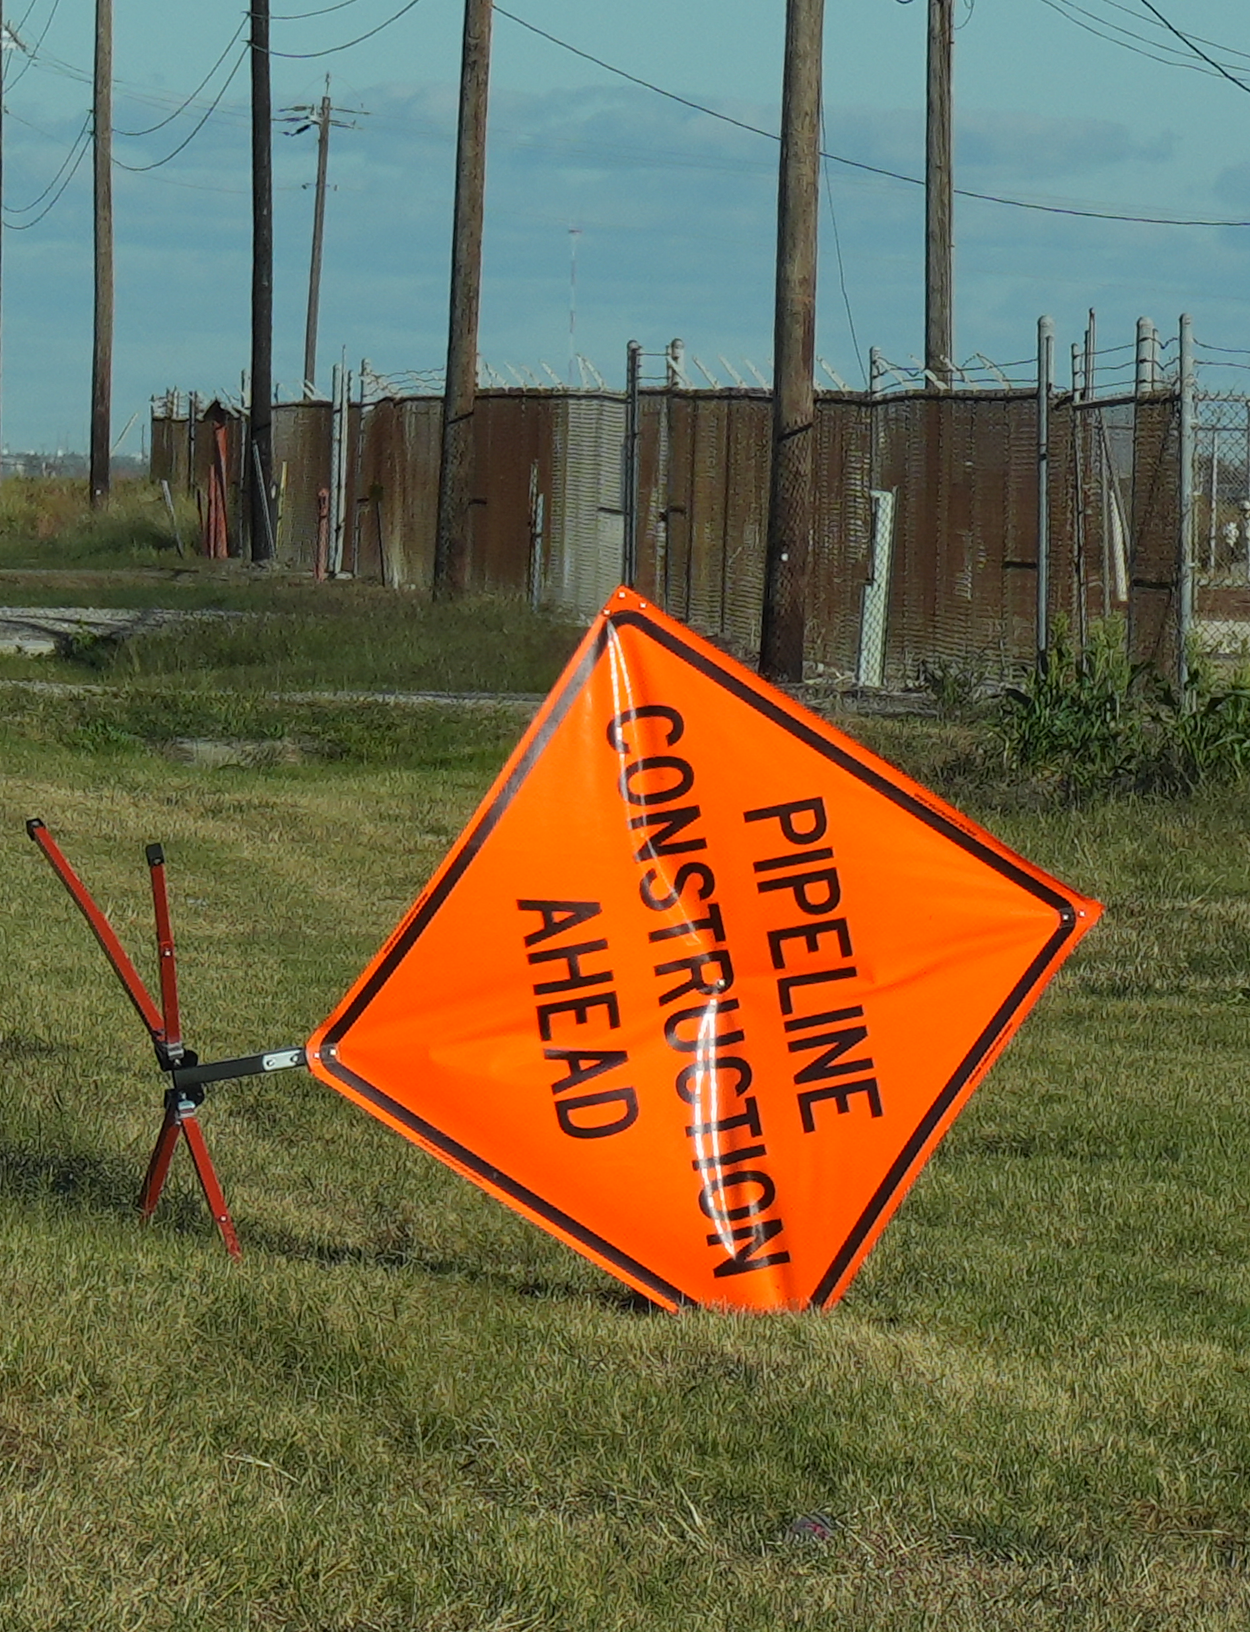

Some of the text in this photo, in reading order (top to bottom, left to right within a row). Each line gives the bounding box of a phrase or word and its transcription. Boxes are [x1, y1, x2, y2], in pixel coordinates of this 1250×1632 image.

[516, 899, 639, 1140] AHEAD
[606, 704, 791, 1278] CONSTRUCTION
[743, 797, 883, 1134] PIPELINE
